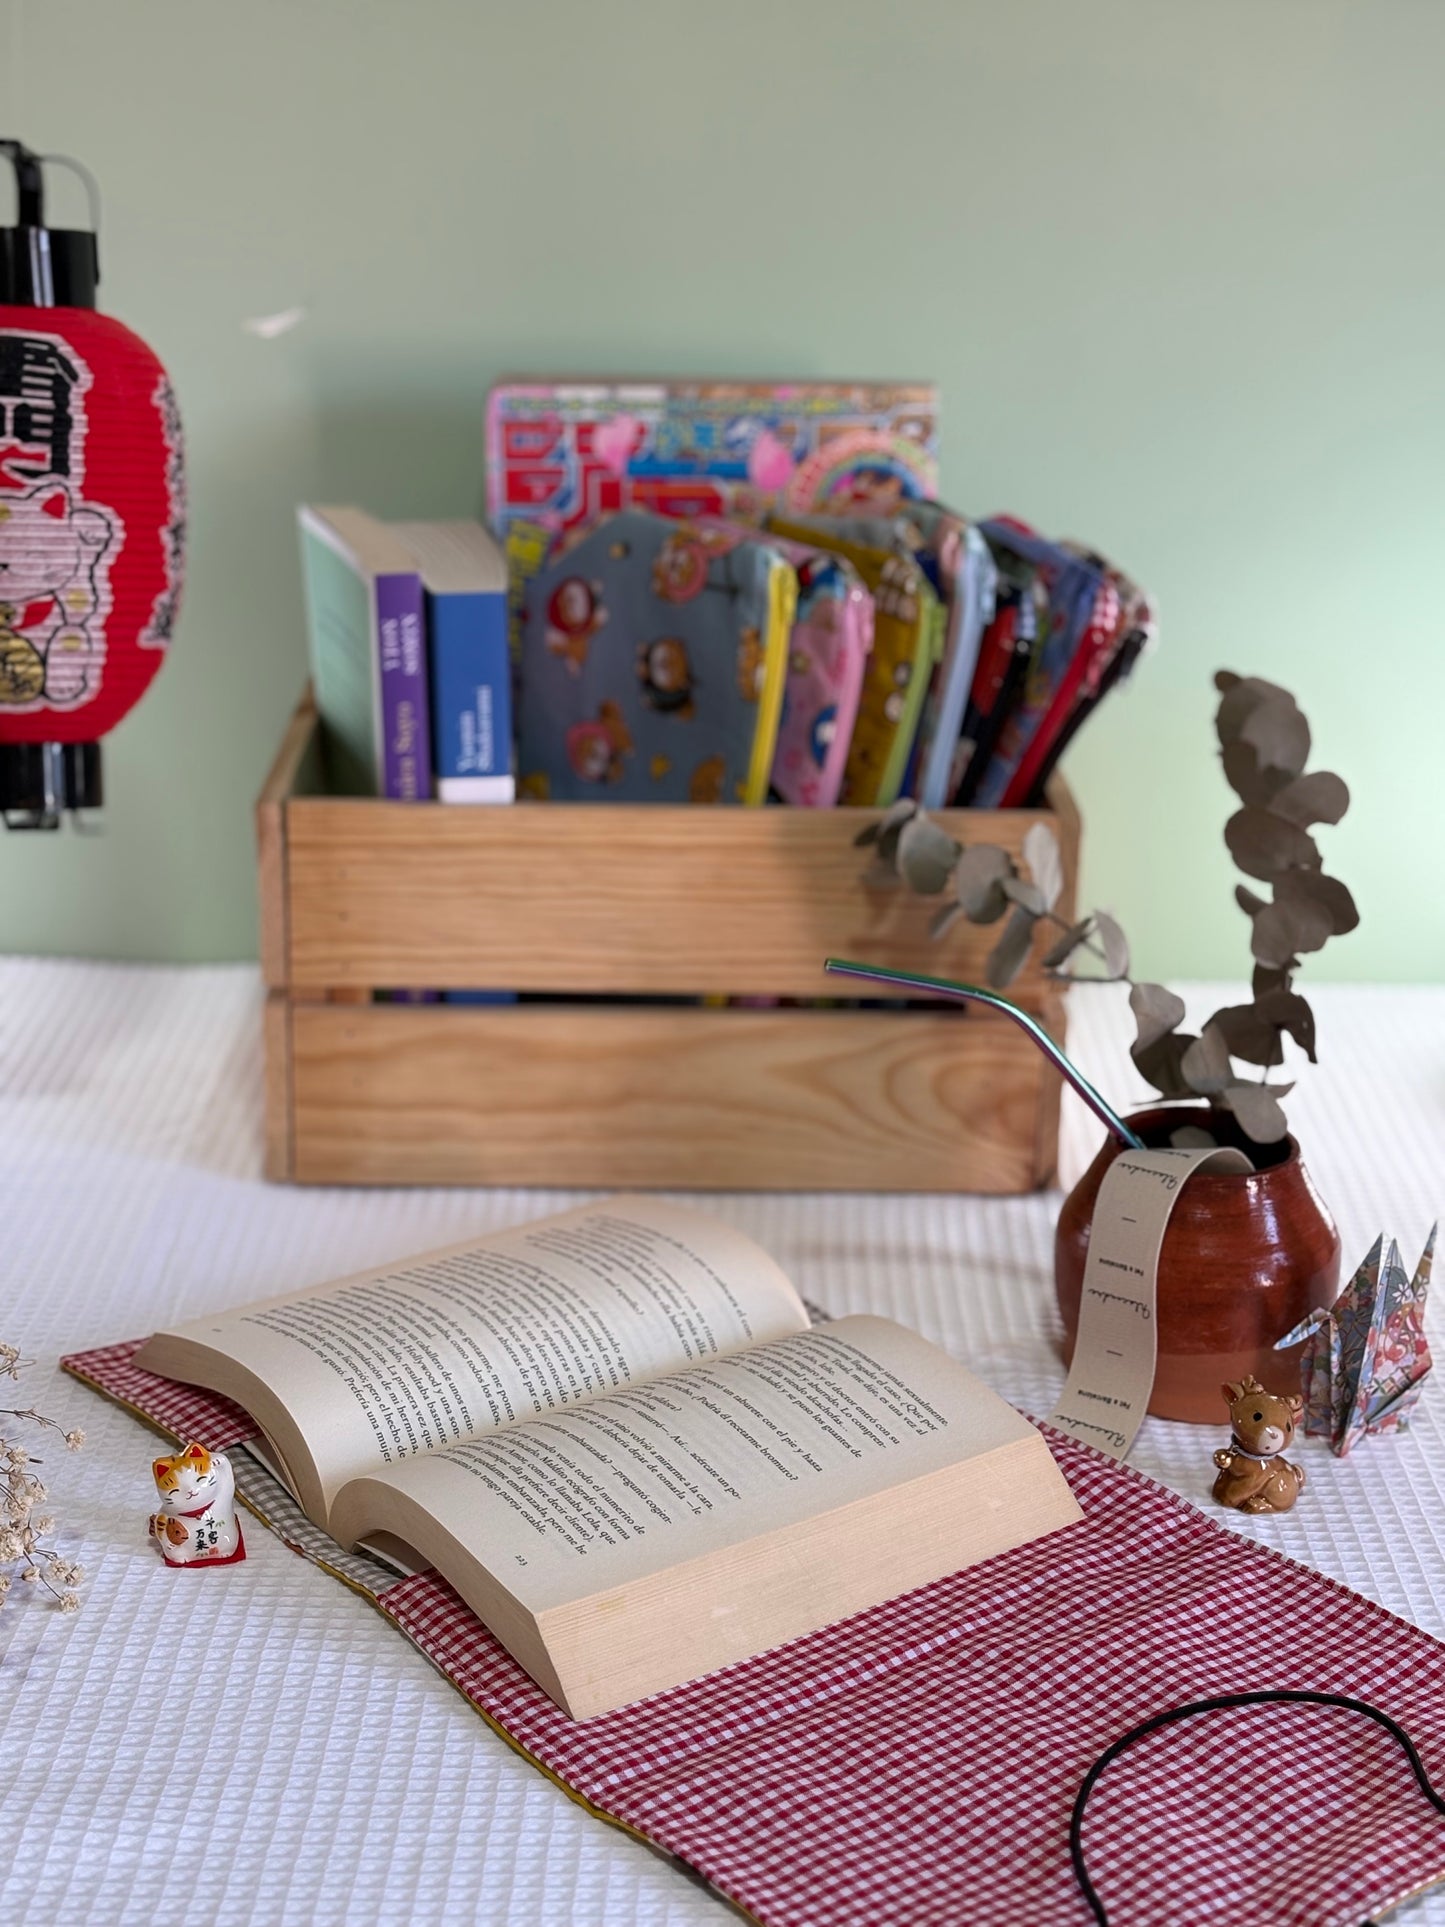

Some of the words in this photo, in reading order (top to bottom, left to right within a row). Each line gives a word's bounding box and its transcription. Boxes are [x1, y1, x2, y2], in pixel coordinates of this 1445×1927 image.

[462, 1336, 493, 1373] gustarme,
[497, 1337, 522, 1366] abiertas
[541, 1329, 570, 1372] espatarras
[568, 1374, 576, 1387] en
[573, 1388, 582, 1399] la
[554, 1329, 576, 1354] pones
[574, 1356, 586, 1374] una
[583, 1375, 592, 1394] ho-
[577, 1315, 608, 1352] eternidad
[602, 1354, 611, 1366] en
[609, 1367, 619, 1386] una
[589, 1310, 620, 1353] demasiado
[618, 1357, 631, 1382] agra-
[681, 1339, 693, 1361] con-
[703, 1326, 718, 1354] ritmo
[362, 1383, 381, 1402] pero
[386, 1365, 397, 1376] La
[391, 1376, 418, 1410] primera
[403, 1344, 441, 1387] Hollywood
[440, 1396, 452, 1415] una
[449, 1416, 460, 1439] son-
[415, 1340, 444, 1370] caballero
[441, 1371, 452, 1381] de
[448, 1382, 464, 1405] unos
[460, 1406, 474, 1434] trein-
[450, 1340, 469, 1359] como
[466, 1360, 484, 1383] todos
[481, 1383, 492, 1398] los
[488, 1400, 501, 1426] años,
[491, 1374, 502, 1388] me
[519, 1368, 529, 1379] de
[519, 1344, 535, 1363] años
[530, 1364, 547, 1386] pero
[542, 1388, 555, 1408] que
[523, 1381, 537, 1397] par
[535, 1343, 569, 1404] desconocido
[592, 1362, 605, 1390] cuan-
[322, 1358, 347, 1377] gustó.
[343, 1377, 370, 1409] Prefería
[366, 1411, 379, 1430] una
[376, 1432, 392, 1463] mujer
[379, 1403, 390, 1412] el
[381, 1380, 391, 1391] de
[388, 1392, 400, 1405] mi
[397, 1405, 419, 1454] hermana,
[401, 1363, 429, 1400] resultaba
[427, 1401, 448, 1445] bastante
[416, 1410, 427, 1428] vez
[496, 1390, 515, 1422] ponen
[533, 1400, 542, 1412] en
[831, 1386, 857, 1406] doctor
[855, 1406, 878, 1423] entró
[875, 1423, 890, 1436] con
[889, 1436, 900, 1444] su
[851, 1374, 864, 1383] me
[863, 1383, 879, 1397] dije,
[888, 1404, 903, 1416] una
[903, 1417, 917, 1428] vez
[883, 1386, 901, 1401] caso.
[900, 1402, 923, 1418] ¿Que
[919, 1419, 938, 1430] por
[903, 1388, 948, 1426] sexualmente.
[384, 1412, 400, 1443] hecho
[397, 1445, 407, 1458] de
[421, 1429, 434, 1449] que
[723, 1388, 734, 1396] un
[733, 1395, 763, 1418] taburete
[762, 1418, 777, 1430] con
[781, 1437, 797, 1448] pie
[802, 1453, 822, 1472] hasta
[726, 1419, 762, 1448] recetarme
[760, 1447, 798, 1480] bromuro?
[792, 1400, 813, 1415] puso
[812, 1414, 825, 1424] los
[821, 1425, 852, 1449] guantes
[850, 1449, 862, 1458] de
[840, 1407, 852, 1418] Lo
[851, 1418, 886, 1448] compren-
[556, 1453, 576, 1469] venía
[574, 1469, 593, 1484] todo
[599, 1492, 634, 1524] numerito
[633, 1525, 645, 1534] de
[628, 1448, 649, 1463] dejar
[646, 1464, 658, 1473] de
[656, 1473, 686, 1500] tomarla
[629, 1433, 654, 1450] volvió
[654, 1455, 686, 1482] mirarme
[688, 1485, 698, 1494] la
[696, 1494, 713, 1510] cara.
[690, 1453, 719, 1477] acércate
[717, 1477, 729, 1487] un
[724, 1487, 741, 1499] po-
[470, 1468, 482, 1476] no
[480, 1475, 501, 1491] tengo
[496, 1491, 522, 1510] pareja
[520, 1510, 546, 1535] estable.
[506, 1480, 548, 1518] embarazada,
[544, 1517, 565, 1533] pero
[563, 1534, 577, 1545] me
[575, 1544, 587, 1555] he
[517, 1474, 549, 1498] prefiere
[547, 1498, 567, 1514] decir
[564, 1515, 594, 1542] cliente).
[527, 1463, 548, 1479] como
[546, 1478, 557, 1487] lo
[554, 1486, 583, 1512] llamaba
[581, 1511, 600, 1531] Lola,
[599, 1531, 616, 1544] que
[566, 1479, 596, 1505] ecógrafo
[594, 1506, 609, 1519] con
[607, 1518, 630, 1540] forma
[646, 1499, 672, 1524] cogien-
[515, 1555, 528, 1566] 223
